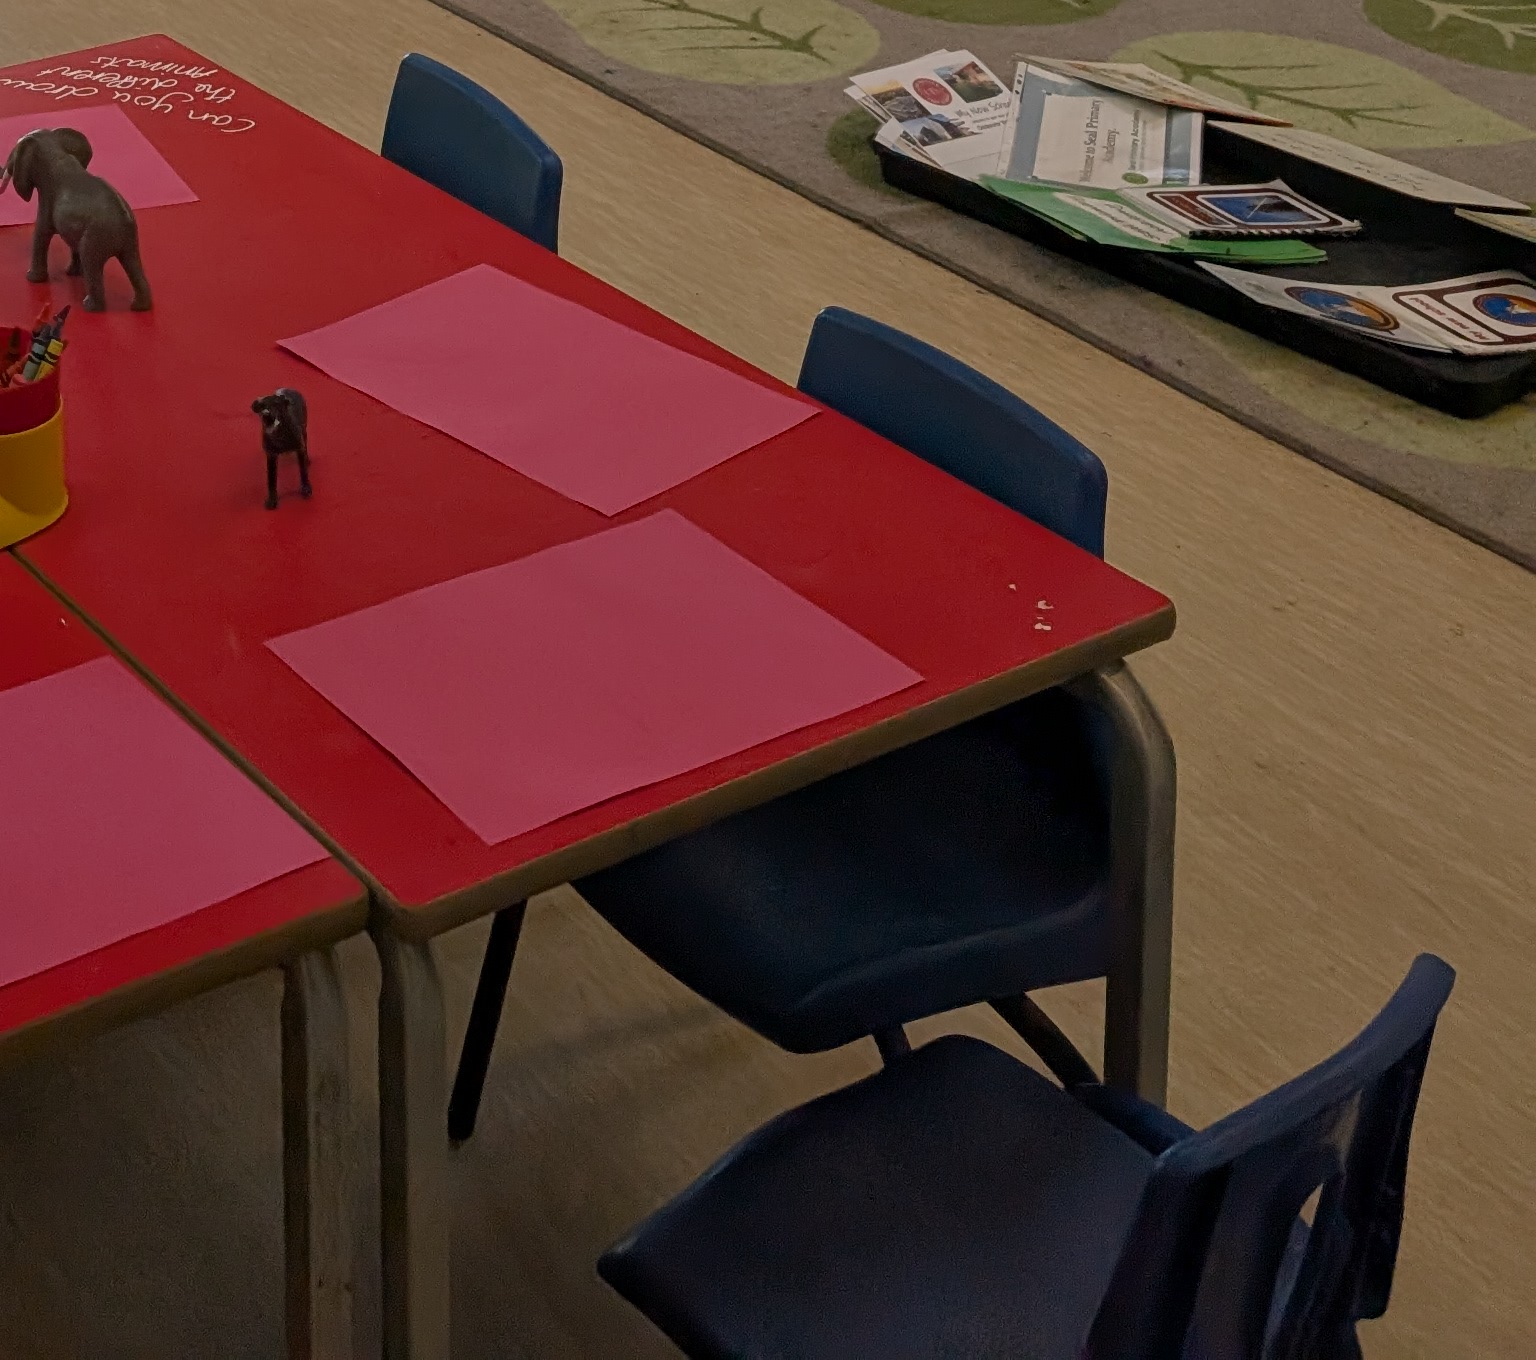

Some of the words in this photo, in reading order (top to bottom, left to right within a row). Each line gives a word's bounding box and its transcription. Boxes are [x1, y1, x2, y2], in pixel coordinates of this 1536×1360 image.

[36, 66, 178, 90] different
[112, 90, 194, 114] you
[194, 80, 236, 103] the
[188, 108, 256, 133] Can
